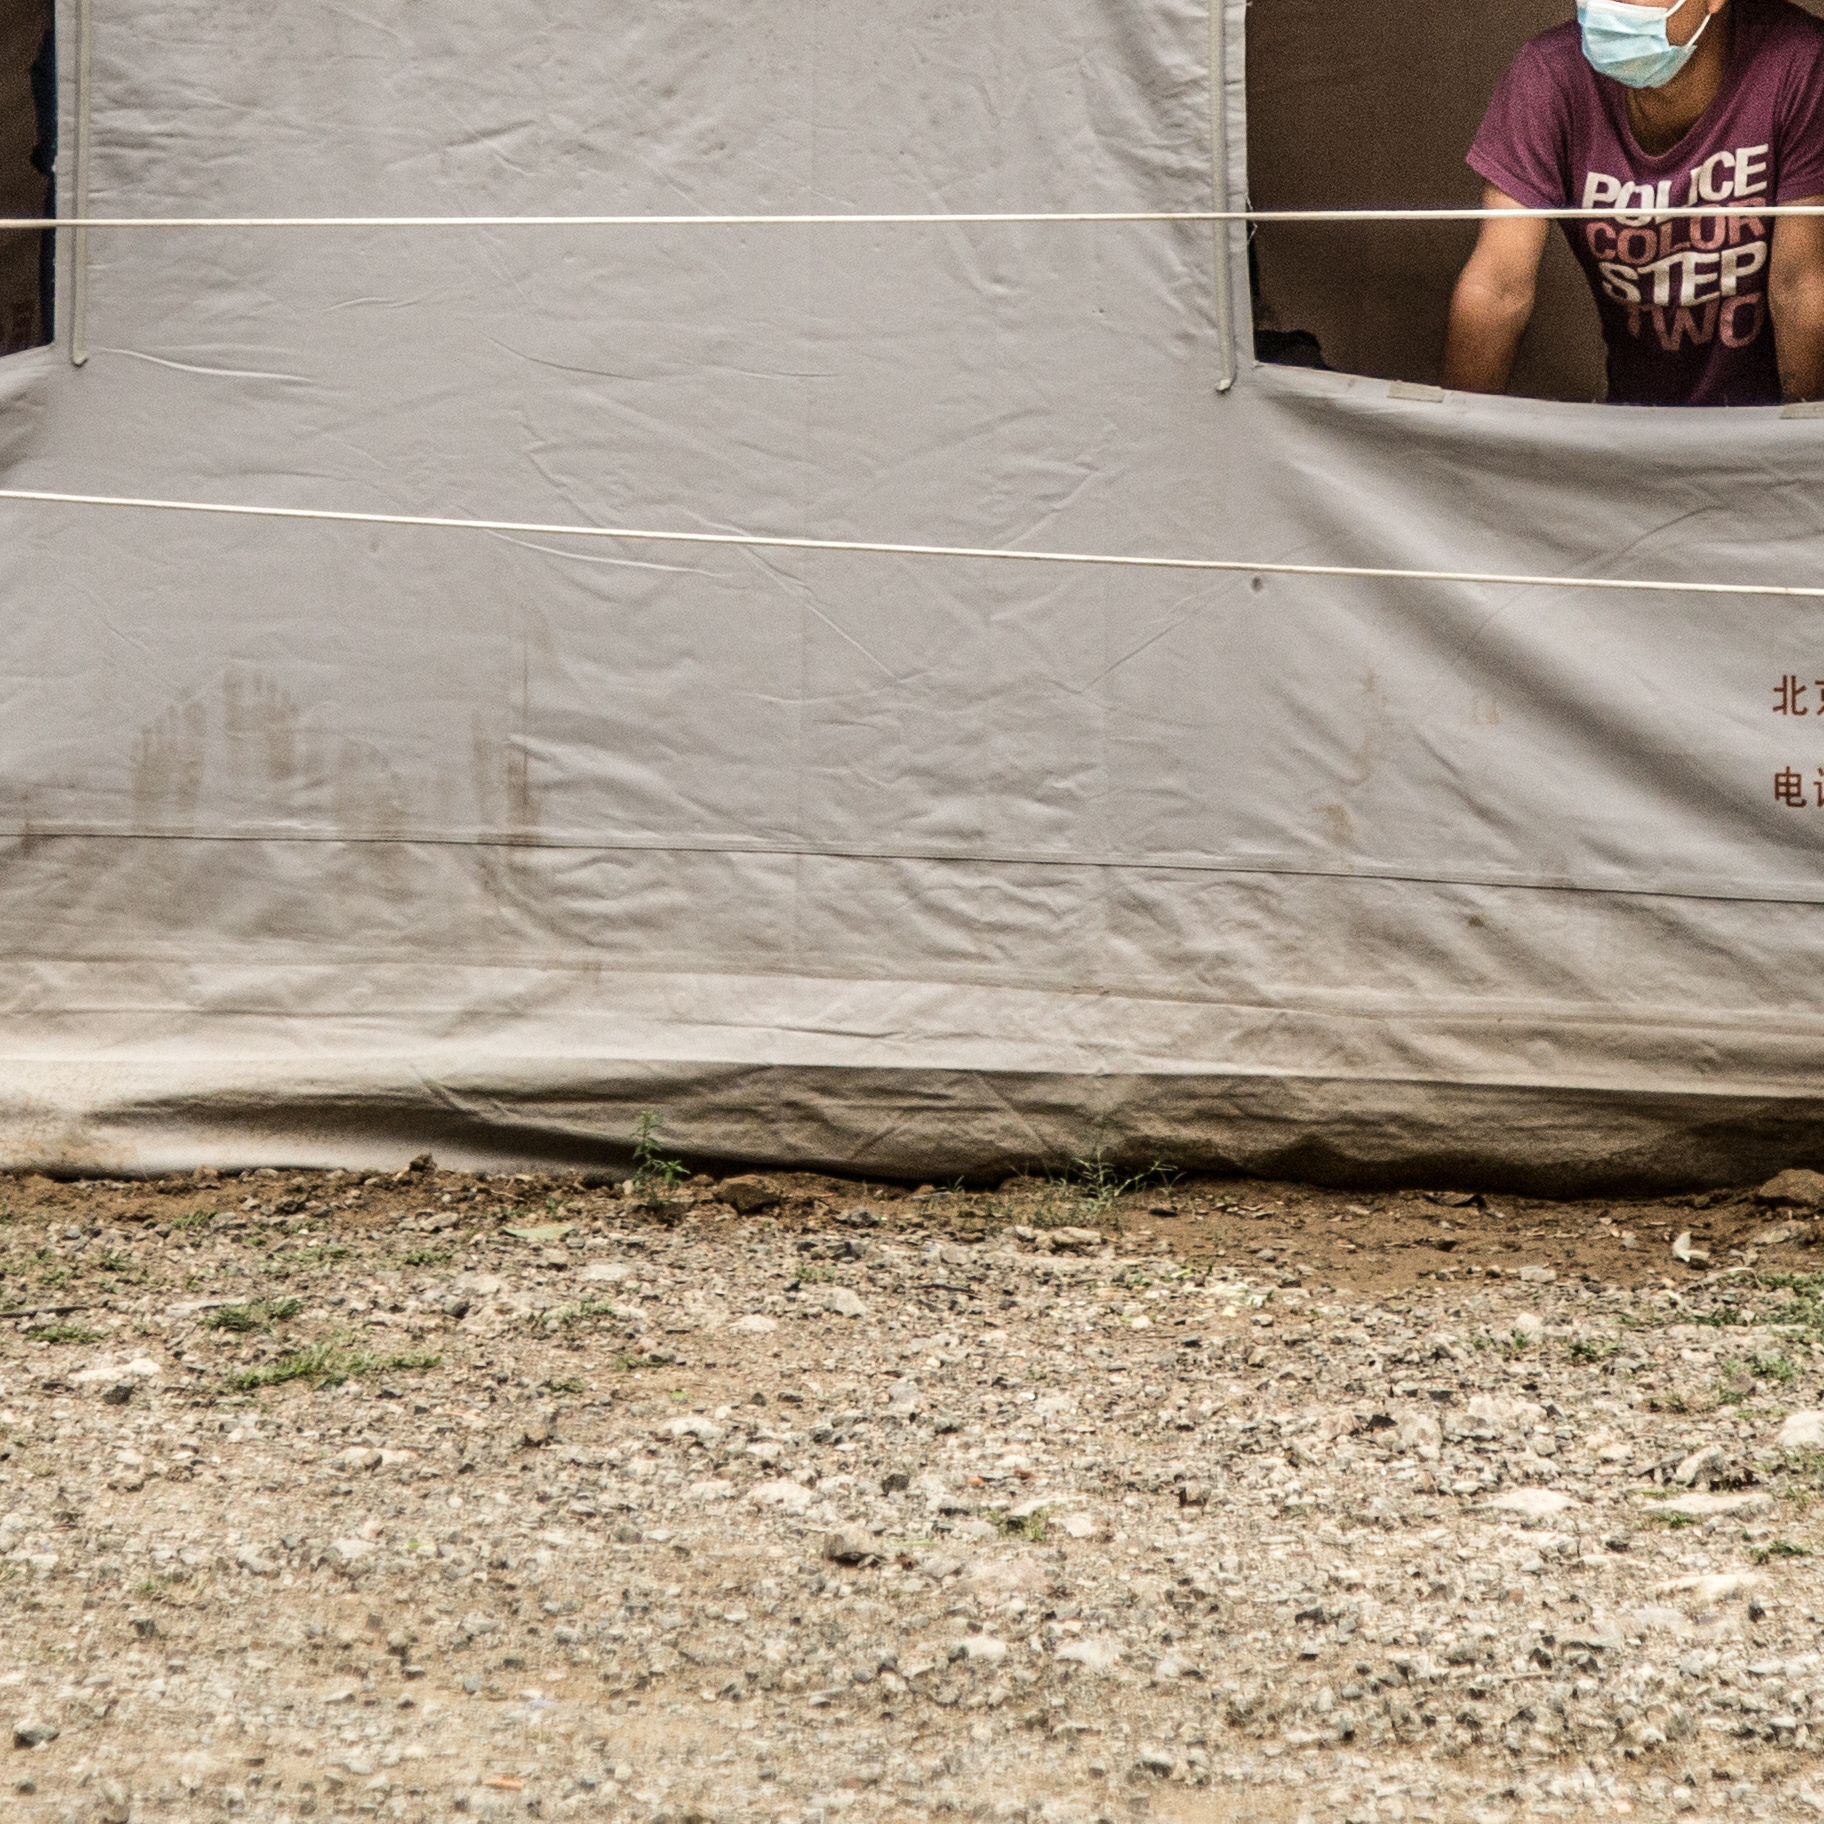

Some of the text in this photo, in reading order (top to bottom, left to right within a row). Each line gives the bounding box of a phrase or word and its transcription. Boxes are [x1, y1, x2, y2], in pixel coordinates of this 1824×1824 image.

[1582, 143, 1769, 227] POLICE
[1586, 197, 1767, 265] COLOR
[1598, 240, 1768, 306] STEP
[1626, 292, 1764, 351] TWO
